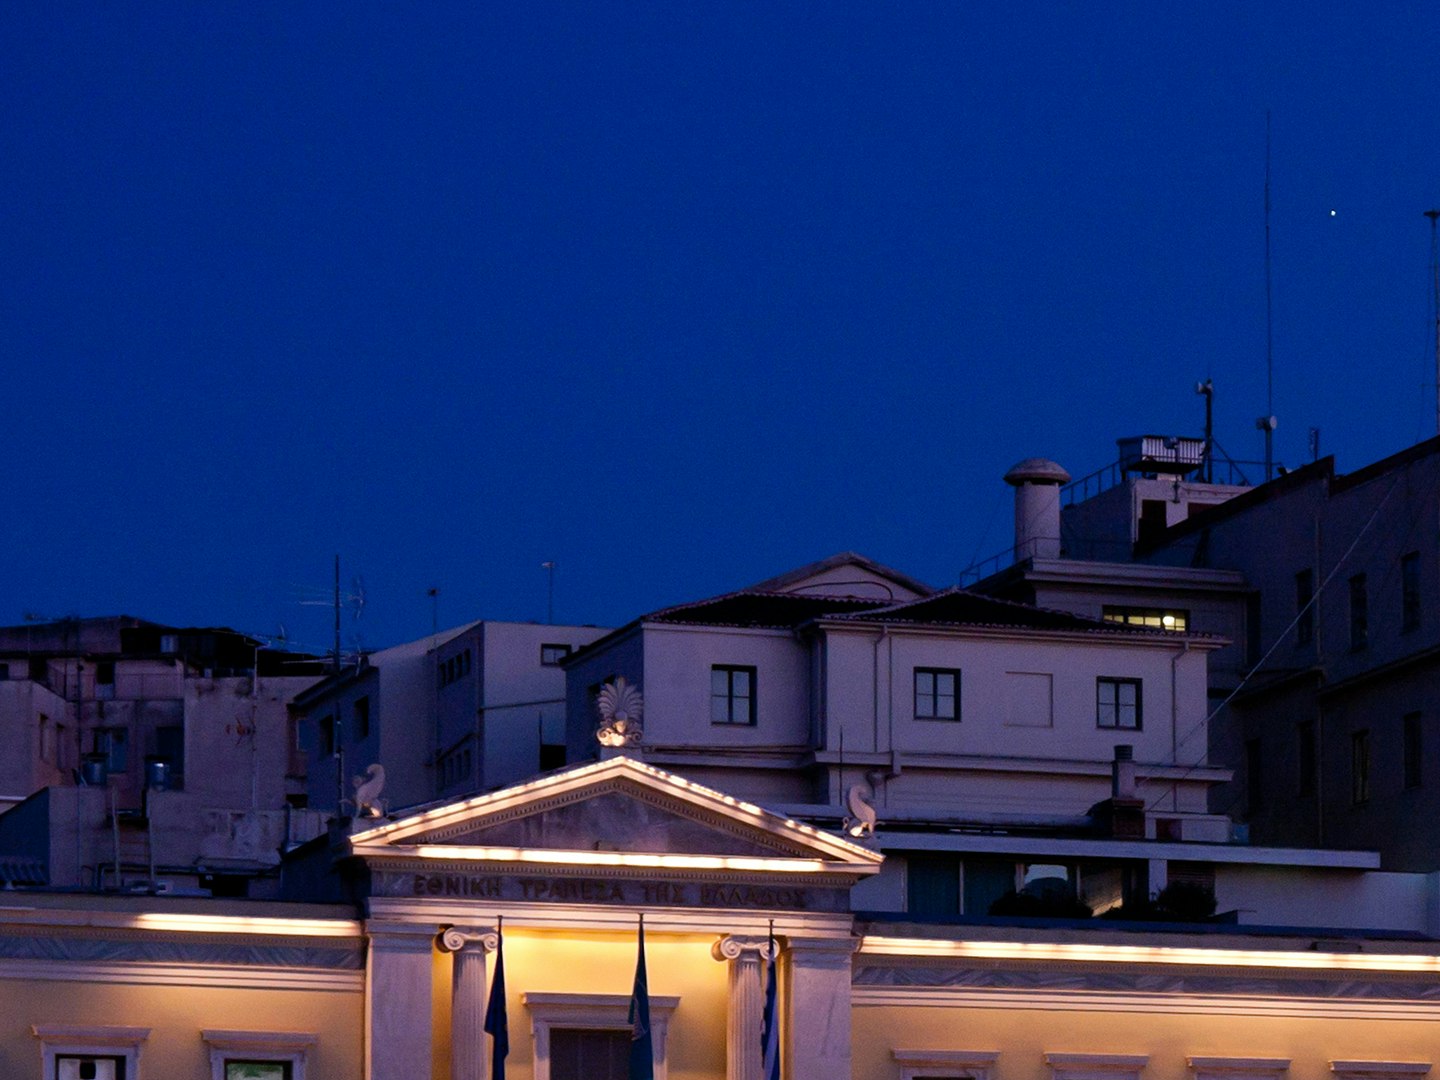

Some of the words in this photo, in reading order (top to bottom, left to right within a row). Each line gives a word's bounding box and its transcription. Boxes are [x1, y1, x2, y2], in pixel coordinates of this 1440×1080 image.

[414, 874, 502, 896] ΕΘΝΙΚΗ
[519, 878, 625, 900] ΤΡΑΠΕΖΑ
[642, 881, 685, 903] ΤΗΣ
[700, 884, 806, 908] ΕΛΛΑΔΟΣ
